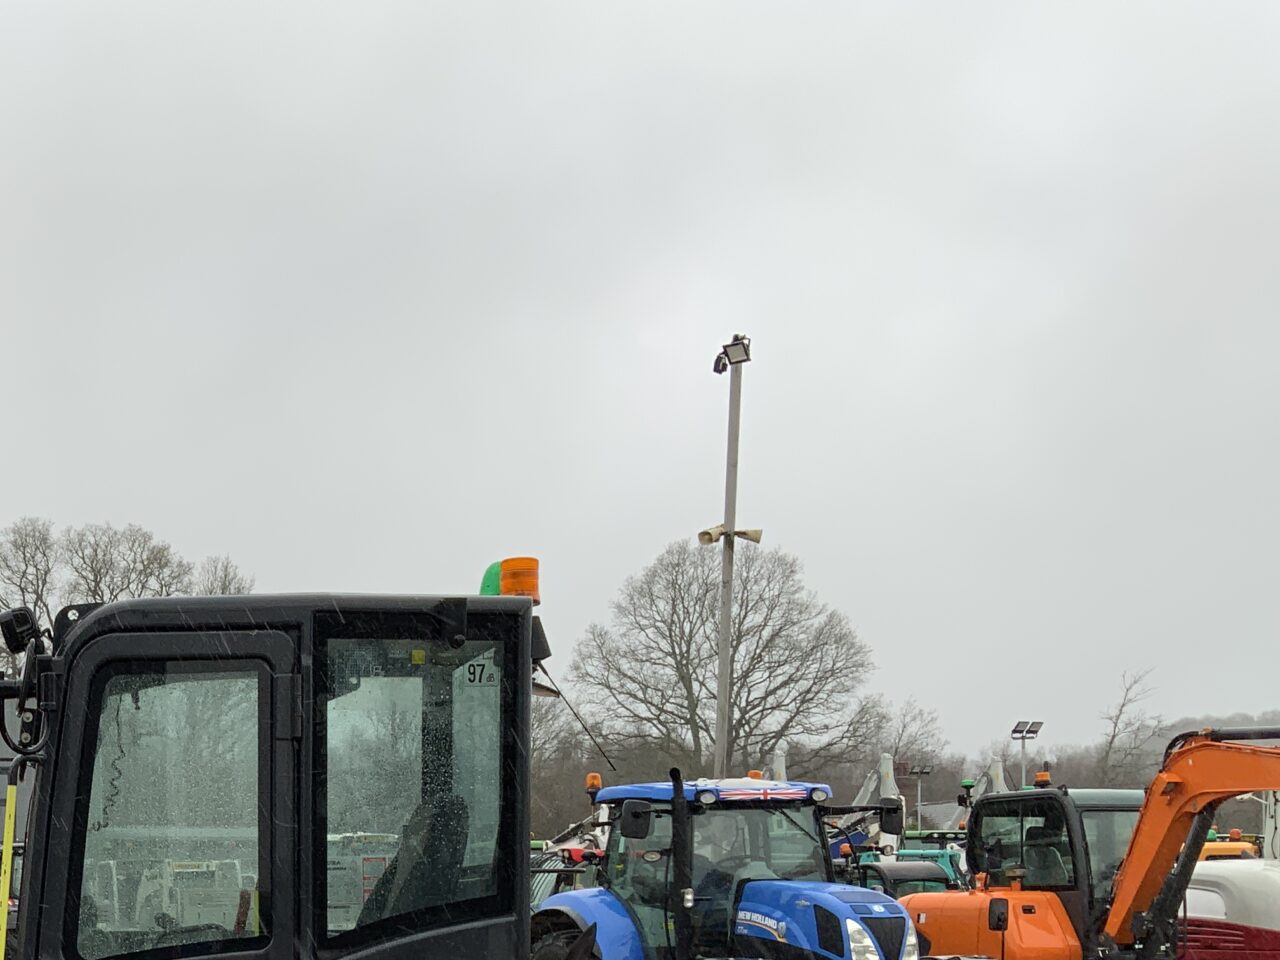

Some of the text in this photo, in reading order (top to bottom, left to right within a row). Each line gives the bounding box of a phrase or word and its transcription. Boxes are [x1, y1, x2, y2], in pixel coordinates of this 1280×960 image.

[468, 663, 485, 683] 97
[737, 911, 777, 929] NEW HOLLAND
